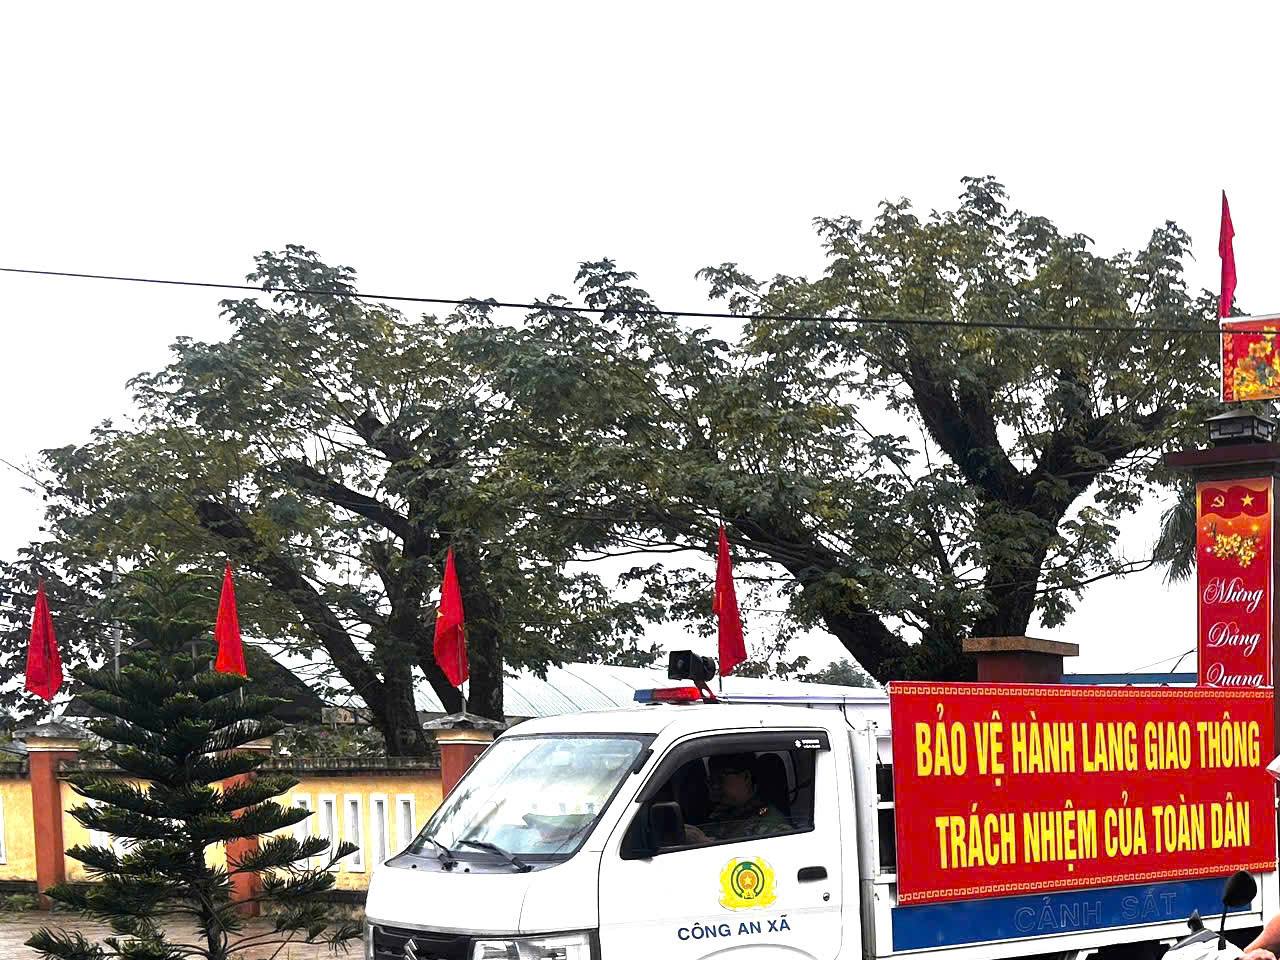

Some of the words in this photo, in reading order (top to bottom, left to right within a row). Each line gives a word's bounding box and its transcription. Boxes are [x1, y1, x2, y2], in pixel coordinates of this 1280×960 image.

[1203, 577, 1264, 614] Mừng
[915, 703, 968, 778] BẢO
[973, 711, 1005, 787] VỆ
[1011, 711, 1075, 775] HÀNH
[1081, 722, 1139, 773] LANG
[1144, 720, 1193, 770] GIAO
[1197, 711, 1261, 769] THÔNG
[935, 802, 1017, 870] TRÁCH
[1022, 799, 1098, 872] NHIỆM
[1104, 790, 1147, 859] CỦA
[1152, 793, 1206, 854] TOÀN
[1210, 792, 1251, 849] DÂN
[677, 922, 732, 941] CÔNG
[738, 921, 762, 936] AN
[767, 914, 791, 933] XÃ
[1014, 896, 1102, 933] CẢNH
